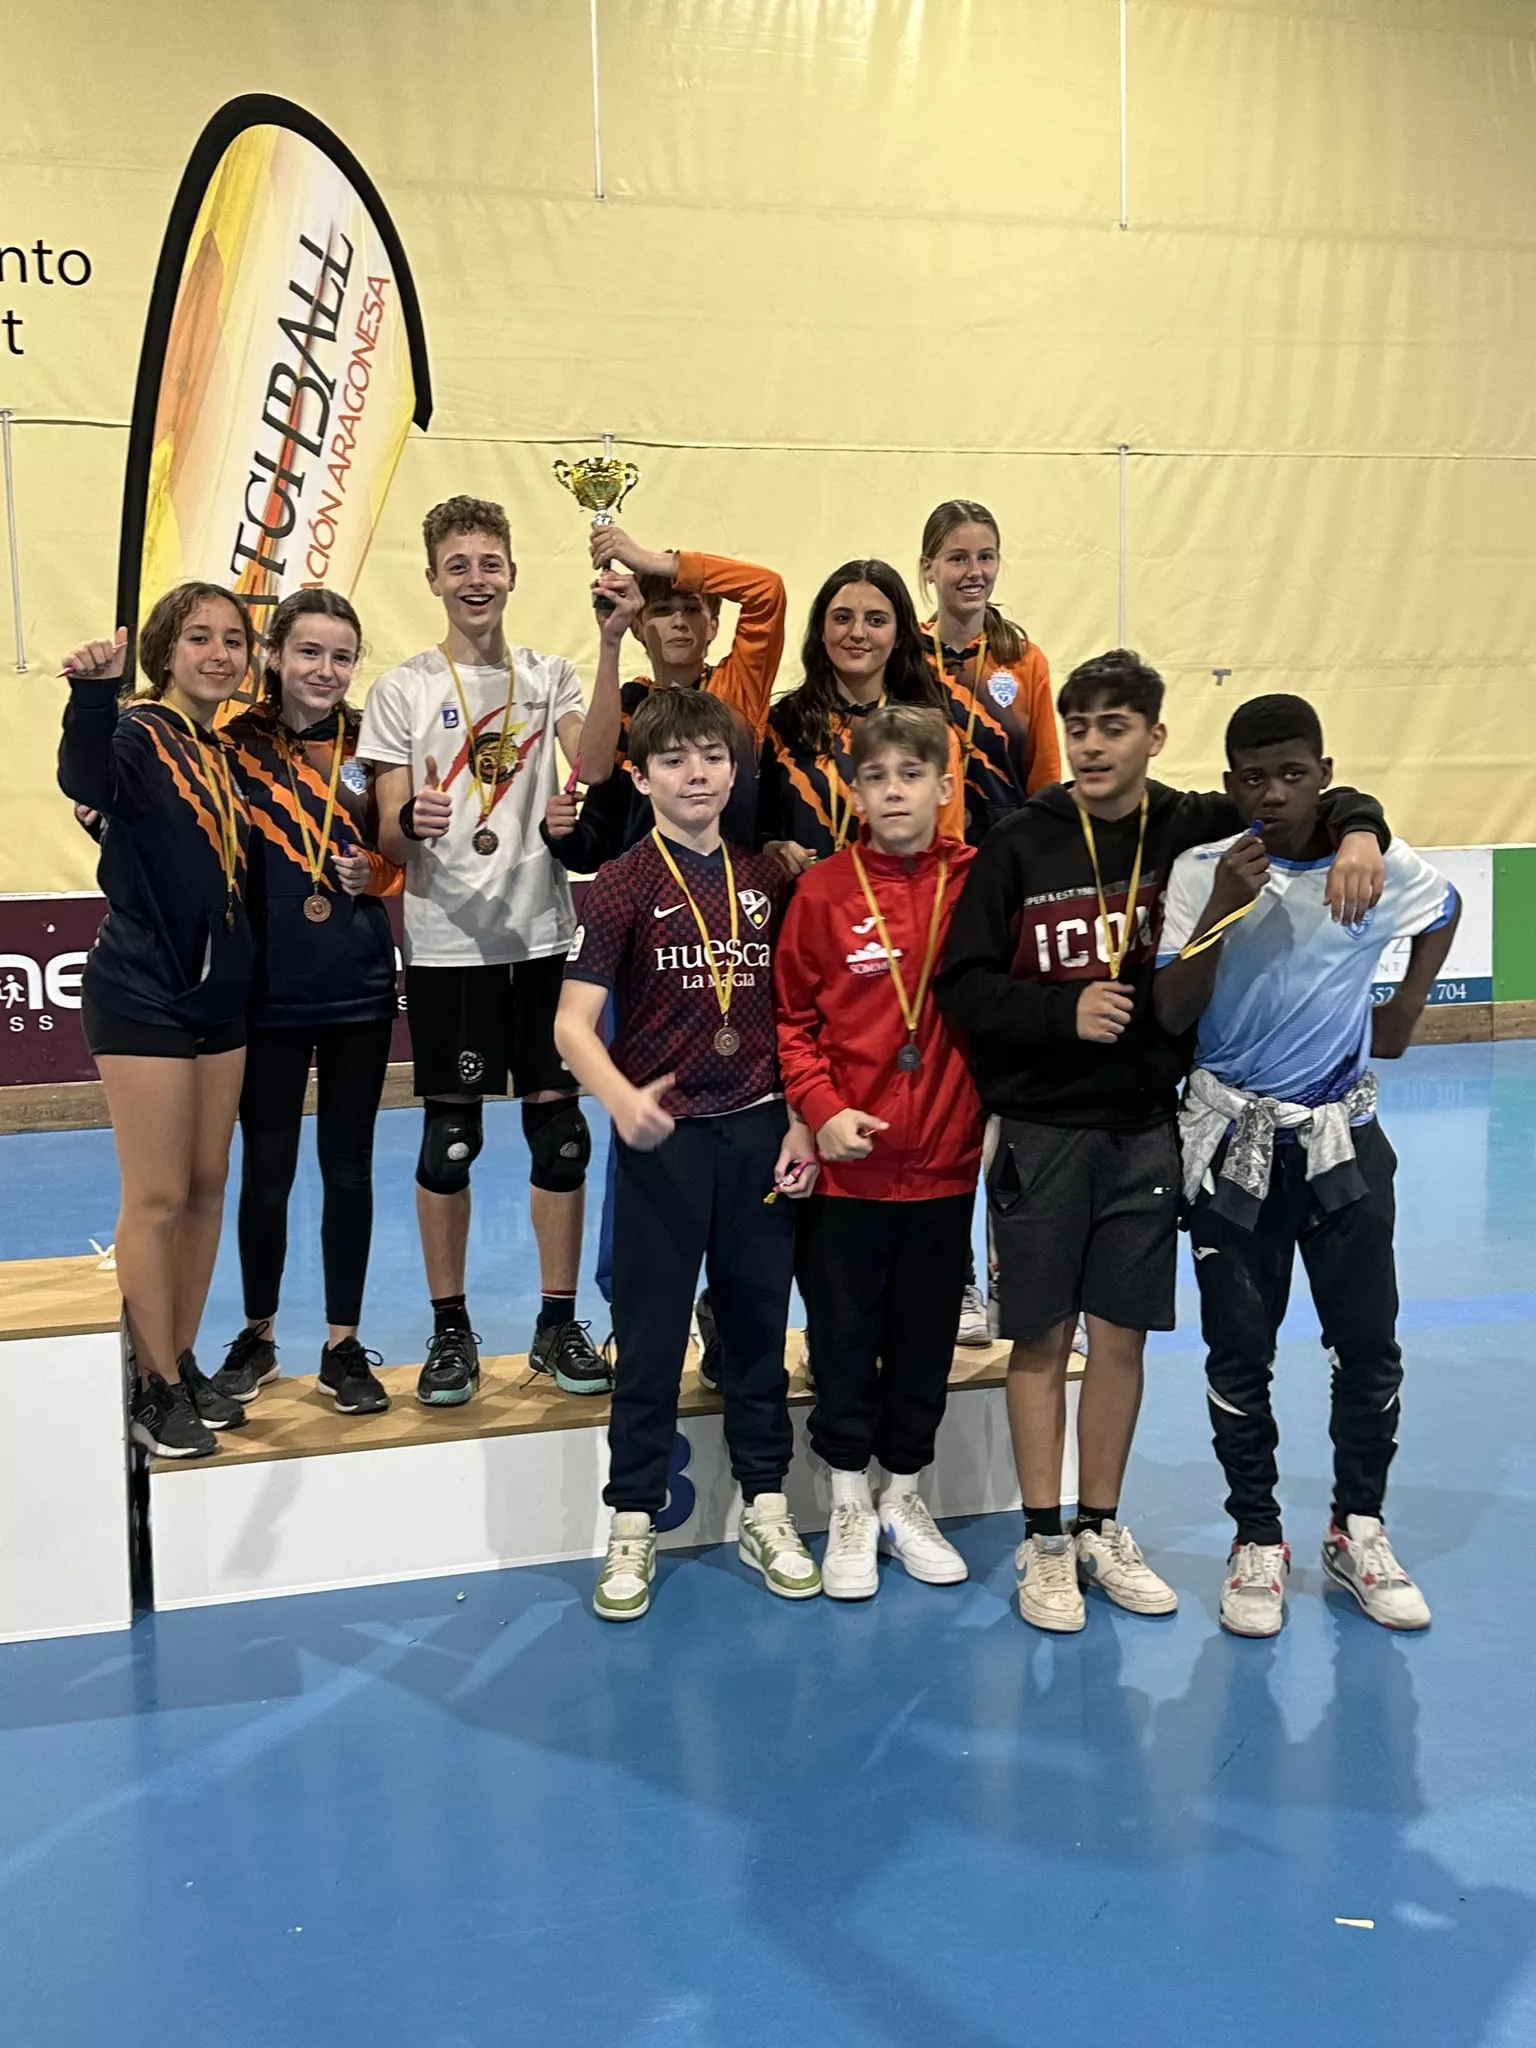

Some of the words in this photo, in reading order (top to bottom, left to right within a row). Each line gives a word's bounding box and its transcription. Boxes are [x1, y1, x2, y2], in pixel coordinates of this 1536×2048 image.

[0, 239, 92, 286] nto
[327, 275, 391, 494] ARAGONESA
[230, 233, 354, 704] TCHBALL
[1436, 983, 1467, 1000] 704
